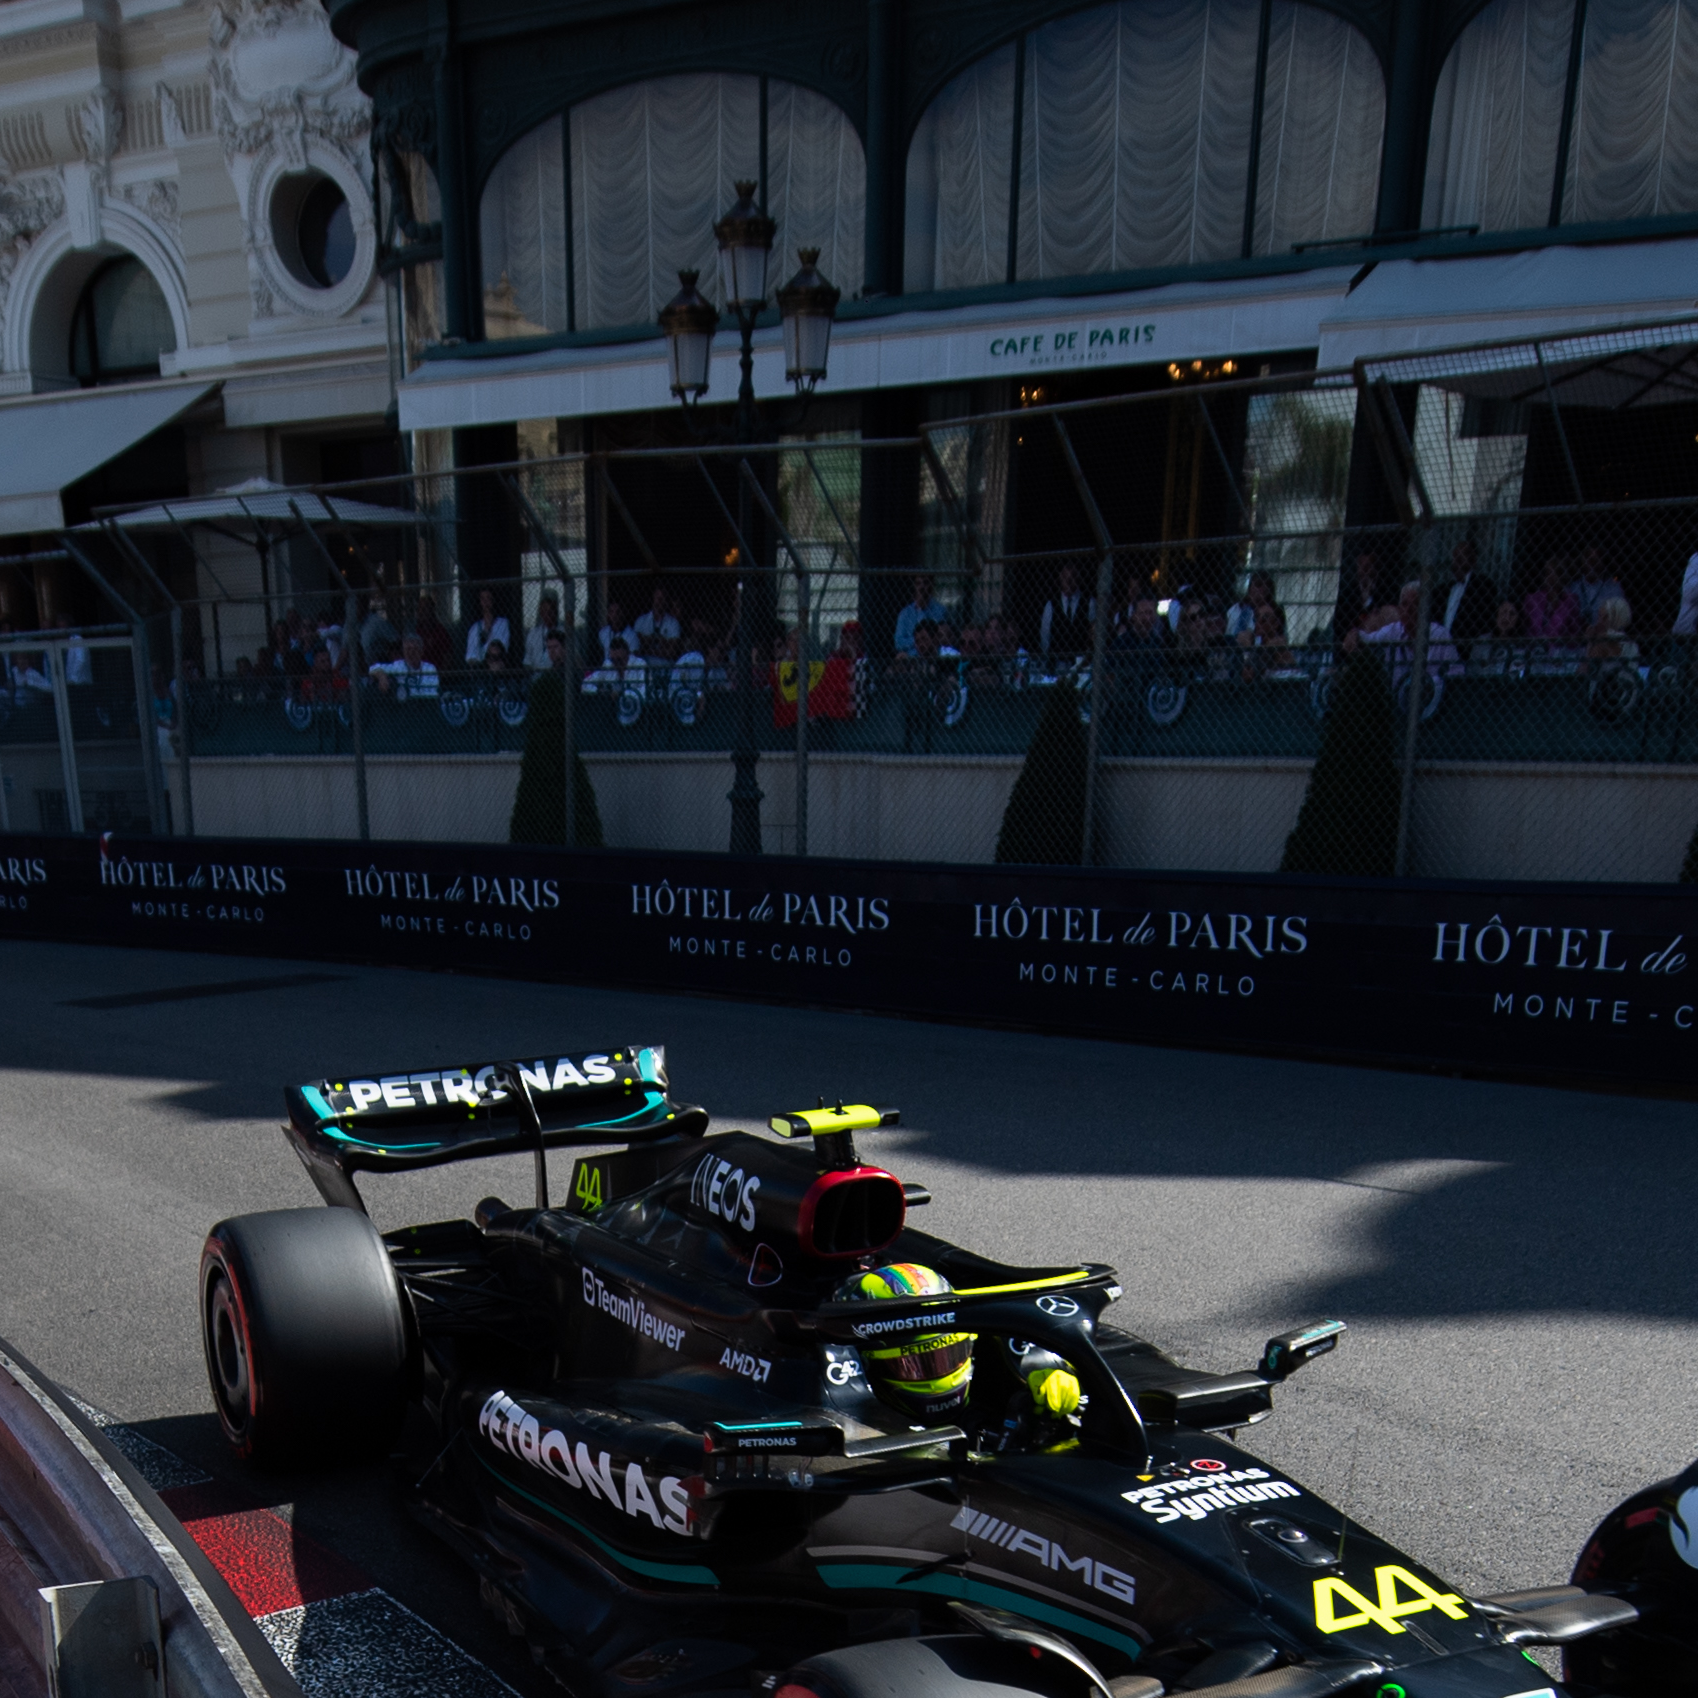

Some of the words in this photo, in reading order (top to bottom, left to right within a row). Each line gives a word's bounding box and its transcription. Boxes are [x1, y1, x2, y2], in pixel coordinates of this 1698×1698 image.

[990, 335, 1044, 357] CAFE
[1054, 331, 1078, 350] DE
[1089, 324, 1157, 347] PARIS
[101, 856, 184, 891] HÔTEL
[188, 864, 206, 890] de
[210, 864, 287, 897] PARIS
[344, 864, 441, 903] HÔTEL
[444, 874, 466, 903] de
[471, 874, 560, 913] PARIS
[630, 878, 742, 923] HÔTEL
[749, 895, 777, 924] de
[781, 893, 891, 935] PARIS
[973, 896, 1113, 946] HÔTEL
[1122, 909, 1158, 947] de
[1167, 909, 1309, 960] PARIS
[1432, 913, 1628, 974] HÔTEL
[1640, 934, 1689, 976] de
[349, 1053, 617, 1110] PETRONAS
[575, 1162, 603, 1213] 44
[690, 1152, 762, 1232] INEOS
[594, 1276, 686, 1352] TeamViewer
[858, 1311, 957, 1335] CROWDSTRIKE
[719, 1346, 755, 1376] AMD
[900, 1333, 962, 1356] PETRONAS
[826, 1359, 862, 1386] G42
[477, 1390, 697, 1537] PETRONAS
[737, 1436, 797, 1448] PETRONAS
[1121, 1467, 1271, 1504] PETRONAS
[1139, 1476, 1302, 1524] Syntium
[1003, 1528, 1137, 1606] AMG
[1312, 1564, 1469, 1635] 44
